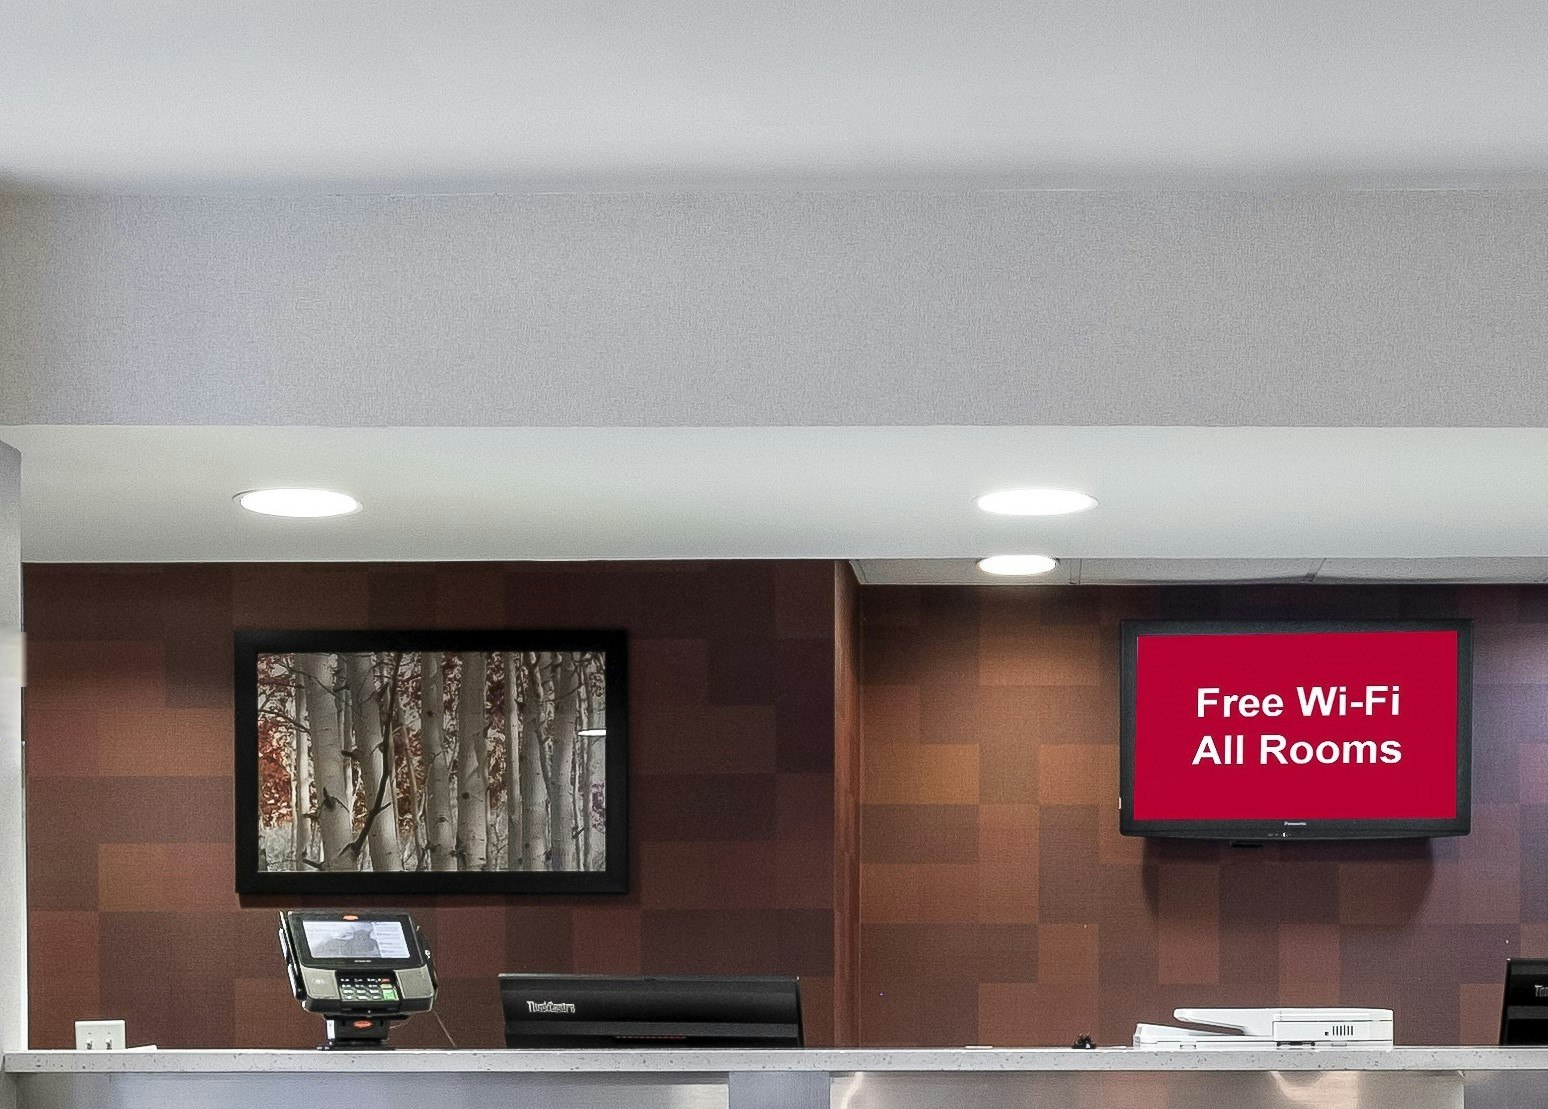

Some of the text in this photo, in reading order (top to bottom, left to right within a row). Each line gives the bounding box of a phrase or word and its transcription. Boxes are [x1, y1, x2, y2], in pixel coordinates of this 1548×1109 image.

[1197, 685, 1400, 718] Free Wi-Fi
[1191, 734, 1402, 765] All Rooms
